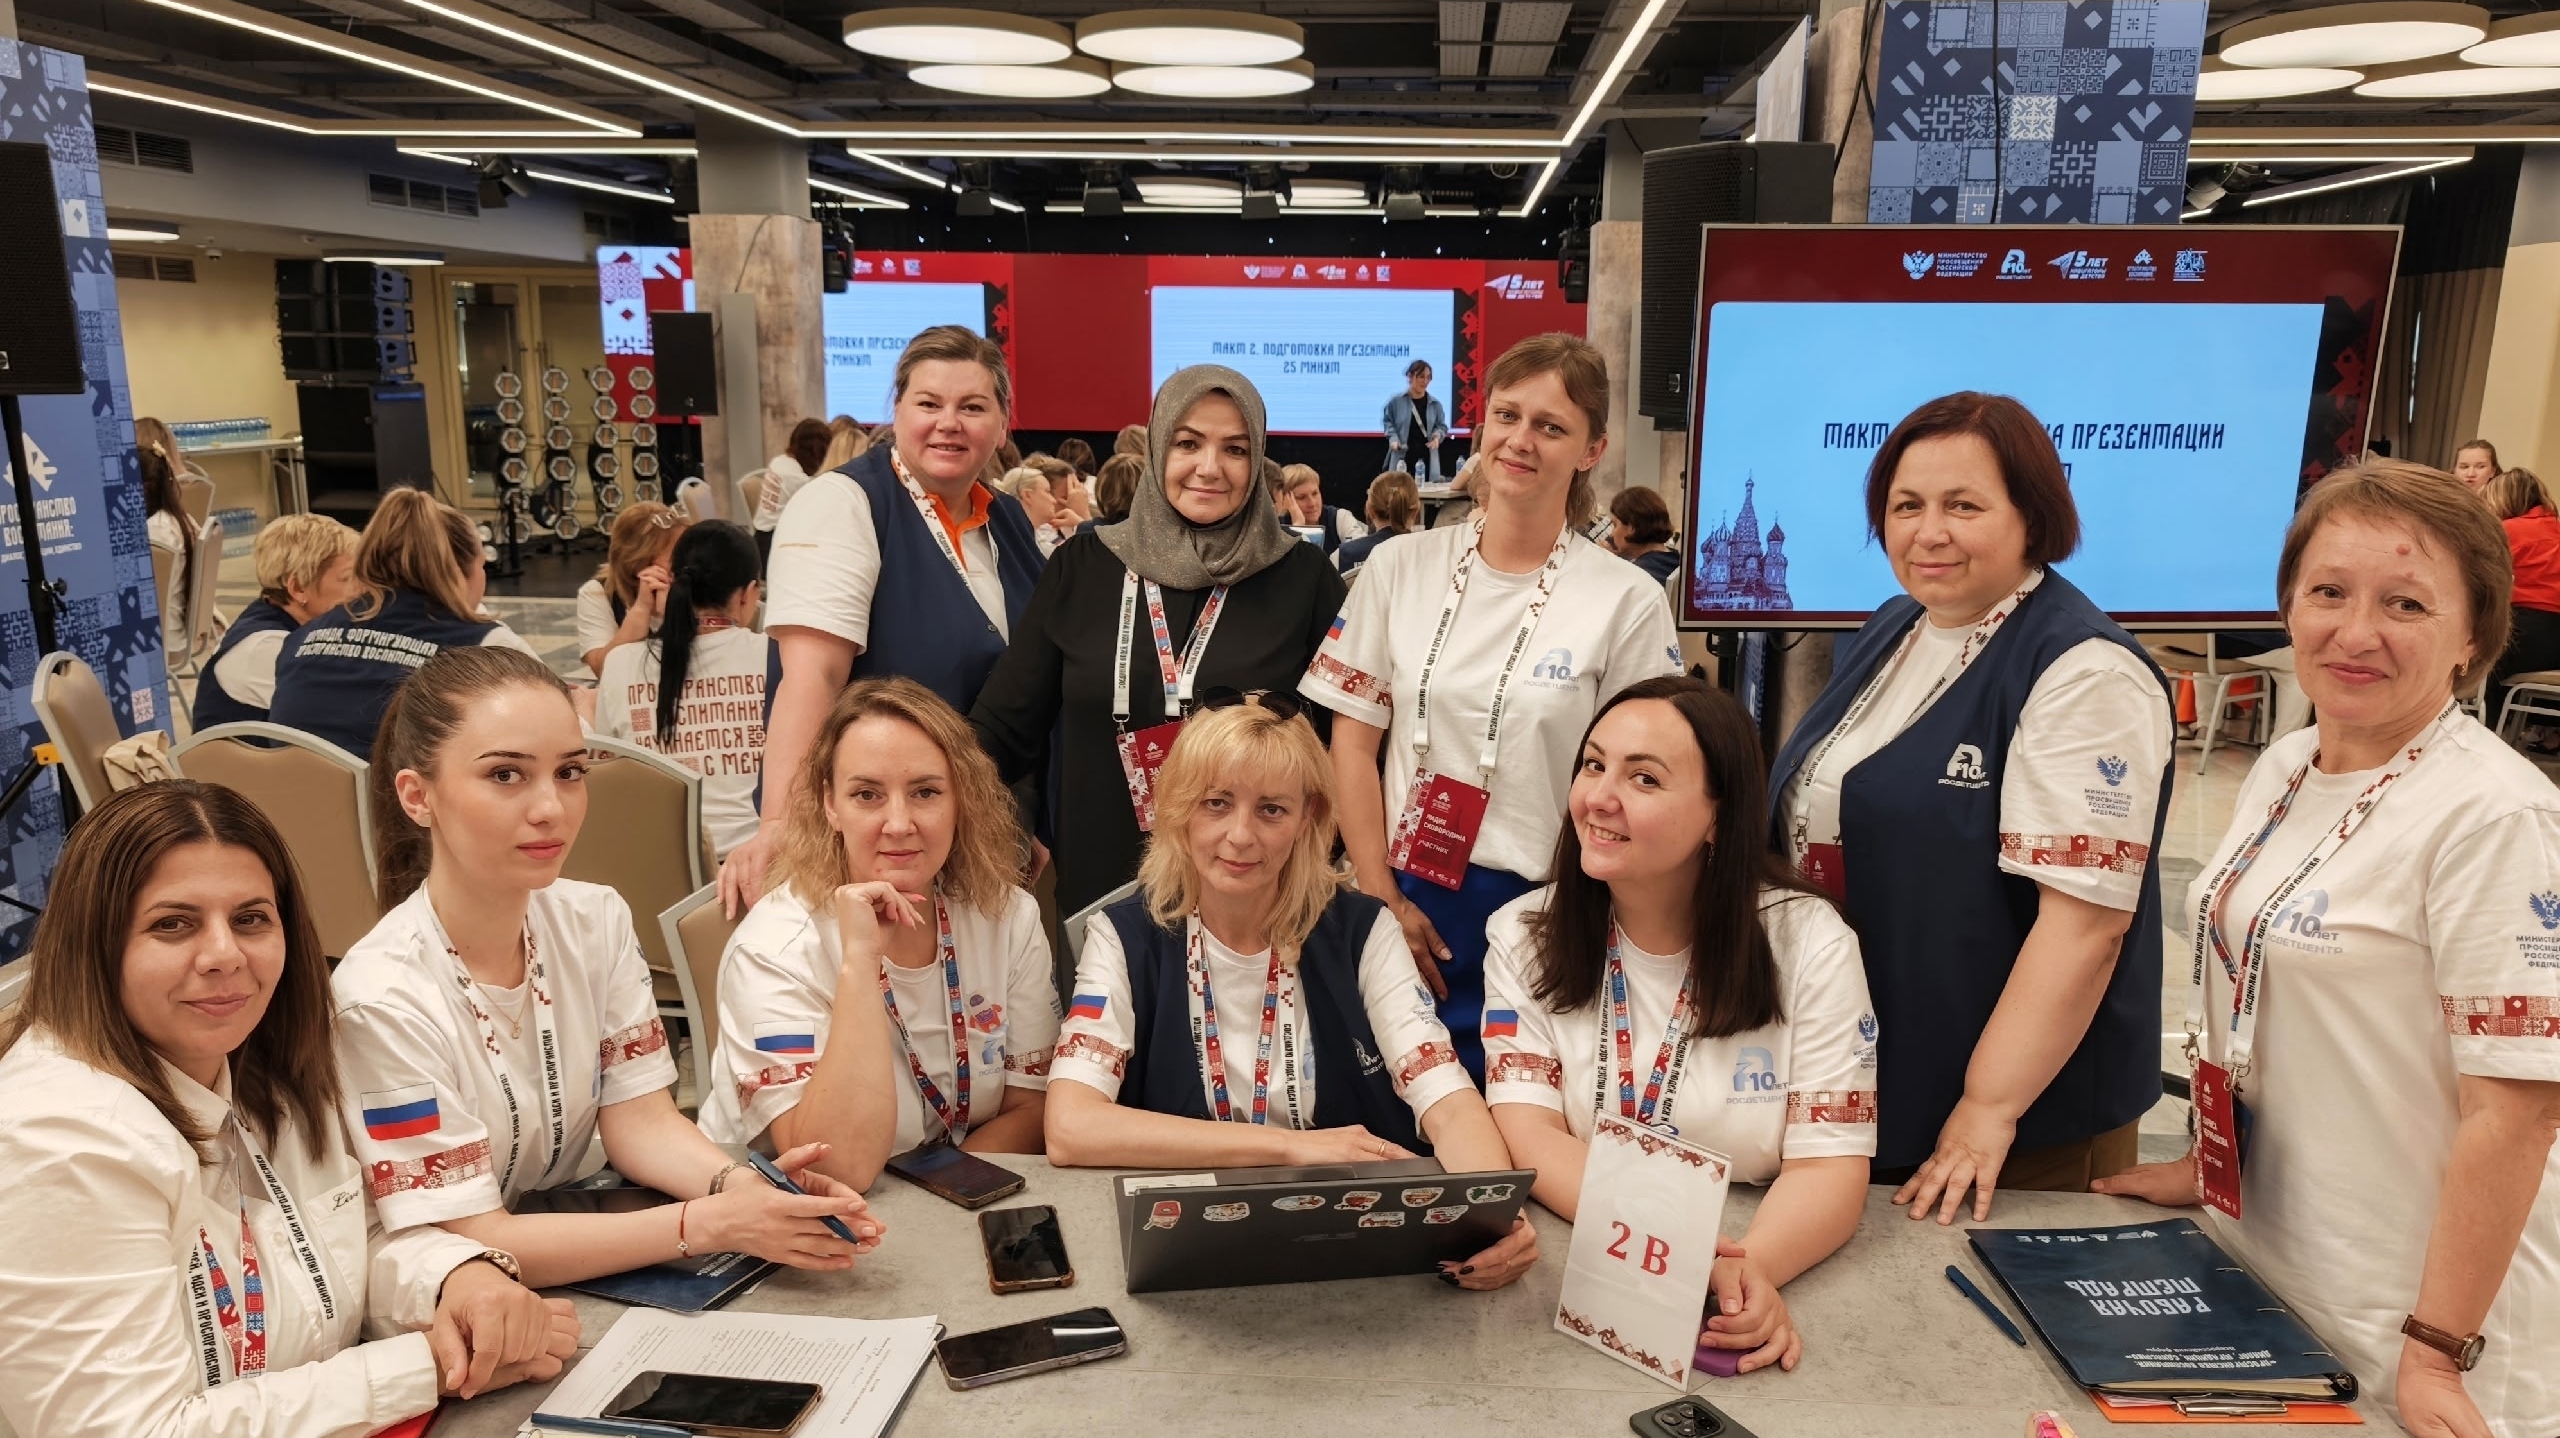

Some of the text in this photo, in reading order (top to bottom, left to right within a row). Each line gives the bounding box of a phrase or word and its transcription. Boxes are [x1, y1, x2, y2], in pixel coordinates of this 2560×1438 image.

[2074, 251, 2109, 267] 5 ЛЕТ
[1263, 343, 1334, 357] ПОДГОТОВКА
[1338, 343, 1410, 358] ПРЕЗЕНТАЦИИ
[1283, 361, 1340, 374] 25 МИНУТ
[1823, 423, 1889, 449] ТАКТ
[2072, 423, 2225, 452] ПРЕЗЕНТАЦИИ
[361, 646, 425, 668] ВОСПИТАНИ
[1548, 665, 1571, 680] 10
[628, 674, 765, 705] ПРОРАНСТВО
[676, 700, 765, 726] СПИТАНИ
[704, 752, 764, 776] С МЕН
[1960, 762, 1982, 779] 10
[2084, 788, 2132, 800] МИНИСТЕРСТВО
[2088, 801, 2130, 812] РОССИЙСКОЙ
[2090, 808, 2128, 818] ФЕДЕРАЦИИ
[1423, 821, 1466, 842] СКОВОРОДИНА
[1417, 839, 1450, 855] УЧАСТНИК
[2227, 832, 2255, 867] СОЕДИНЯЮ
[2200, 893, 2212, 915] ИДЕИ
[2243, 973, 2257, 1016] СОЕДИНЯЮ
[2250, 942, 2263, 973] ЛЮДЕЙ,
[2257, 915, 2270, 940] ИДЕИ
[2270, 857, 2322, 911] ПРОСТРАНСТВА
[2289, 911, 2339, 941] 10 лет
[2193, 922, 2205, 986] ПРОСТРАНСТВА
[2267, 933, 2343, 955] СДЕТЦЕНТР
[1284, 1024, 1294, 1058] СОЕДИНЯЮ
[1671, 1032, 1689, 1068] СОЕДИНЯЮ
[542, 1029, 558, 1090] ПРОСТРАНСТВА
[1665, 1069, 1681, 1095] ЛЮДЕЙ,
[1749, 1071, 1789, 1091] 10 лет
[500, 1073, 518, 1113] СОЕДИНЯЮ
[1287, 1085, 1297, 1102] ИДЕИ
[1726, 1095, 1787, 1105] РОСДЕТЦЕНТ
[552, 1097, 563, 1119] ИДЕИ
[1661, 1095, 1673, 1116] ИДЕИ
[254, 1154, 293, 1214] ПРОСТРАНСТВА
[289, 1221, 306, 1243] ИДЕИ
[1606, 1220, 1631, 1261] 2
[300, 1243, 320, 1274] ЛЮДЕЙ,
[191, 1274, 208, 1301] ИДЕИ
[313, 1274, 334, 1320] СОЕДИНЯЮ
[2064, 1276, 2202, 1297] ТЕТРАДЬ
[2089, 1296, 2212, 1316] РАБОЧАЯ
[197, 1308, 221, 1387] ПРОСТРАНСТВА
